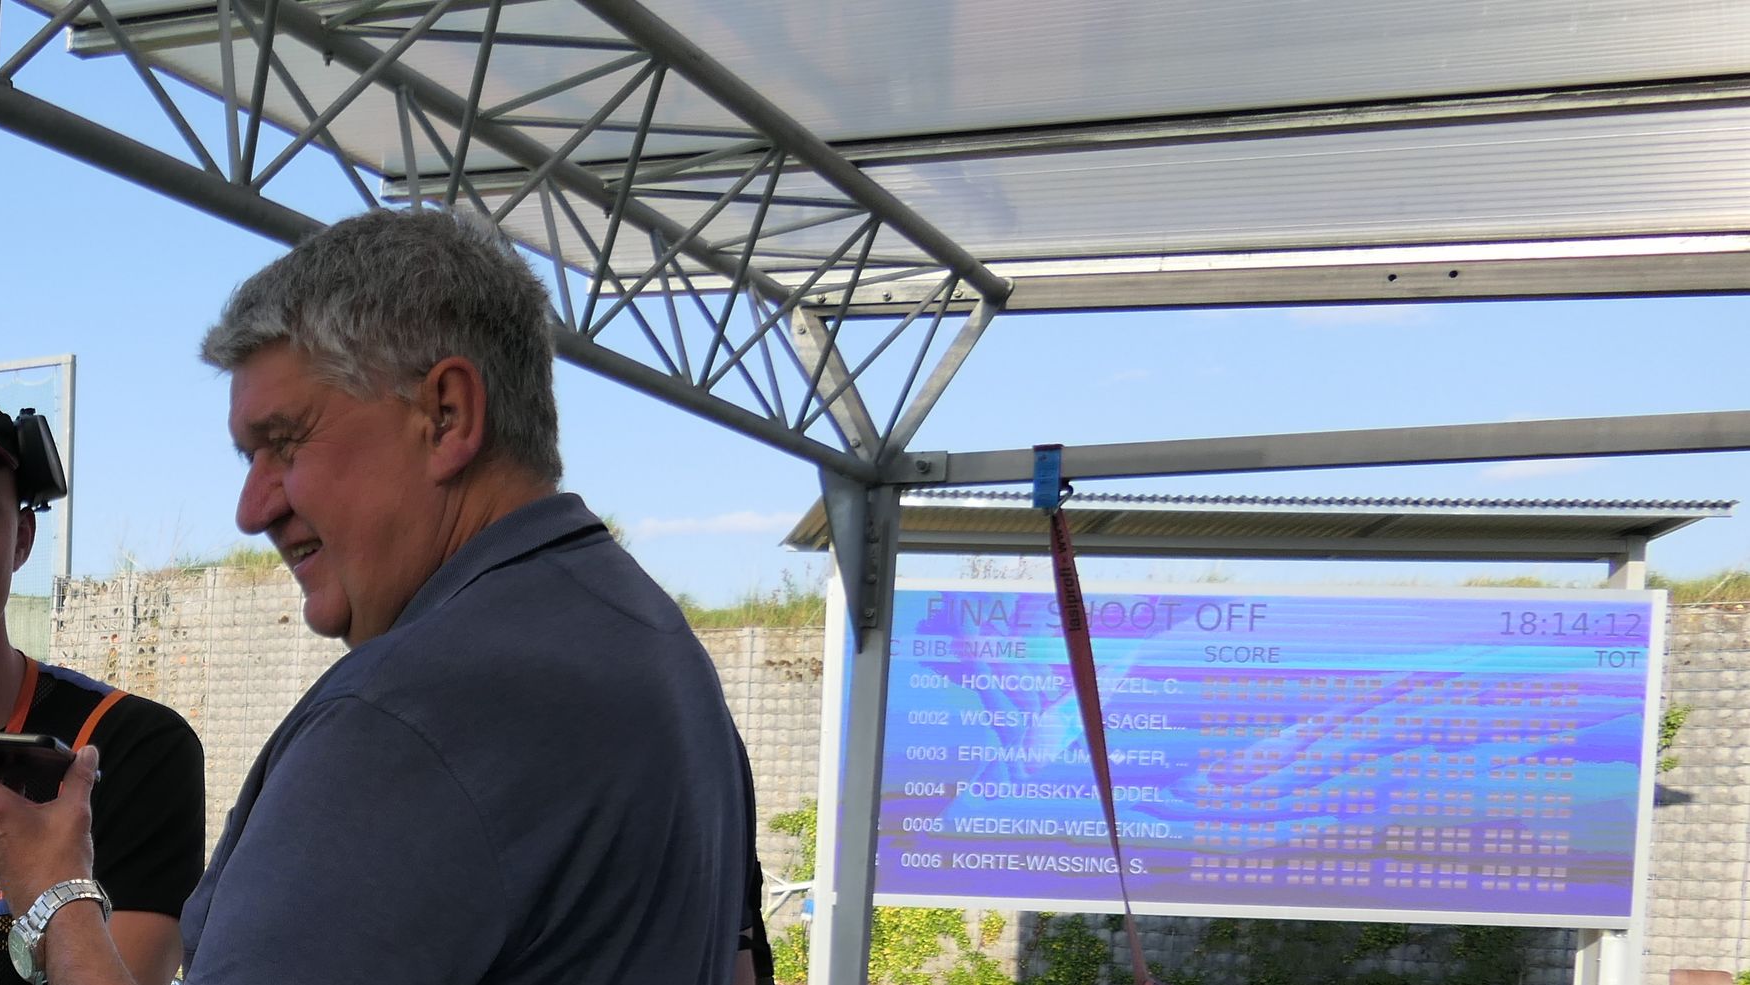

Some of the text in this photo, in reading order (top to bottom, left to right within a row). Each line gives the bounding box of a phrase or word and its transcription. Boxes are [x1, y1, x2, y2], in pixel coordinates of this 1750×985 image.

[927, 598, 1032, 628] FINAL
[1195, 602, 1268, 632] OFF
[1500, 611, 1642, 638] 18:14:12
[912, 640, 947, 657] BIB
[965, 641, 1027, 659] NAME
[1203, 645, 1281, 664] SCORE
[1593, 650, 1641, 669] TOT
[909, 674, 950, 689] 0001
[1163, 678, 1184, 695] C.
[907, 711, 950, 725] 0002
[906, 746, 947, 761] 0003
[904, 782, 945, 796] 0004
[902, 817, 944, 832] 0005
[900, 853, 943, 868] 0006
[1129, 857, 1149, 874] S.
